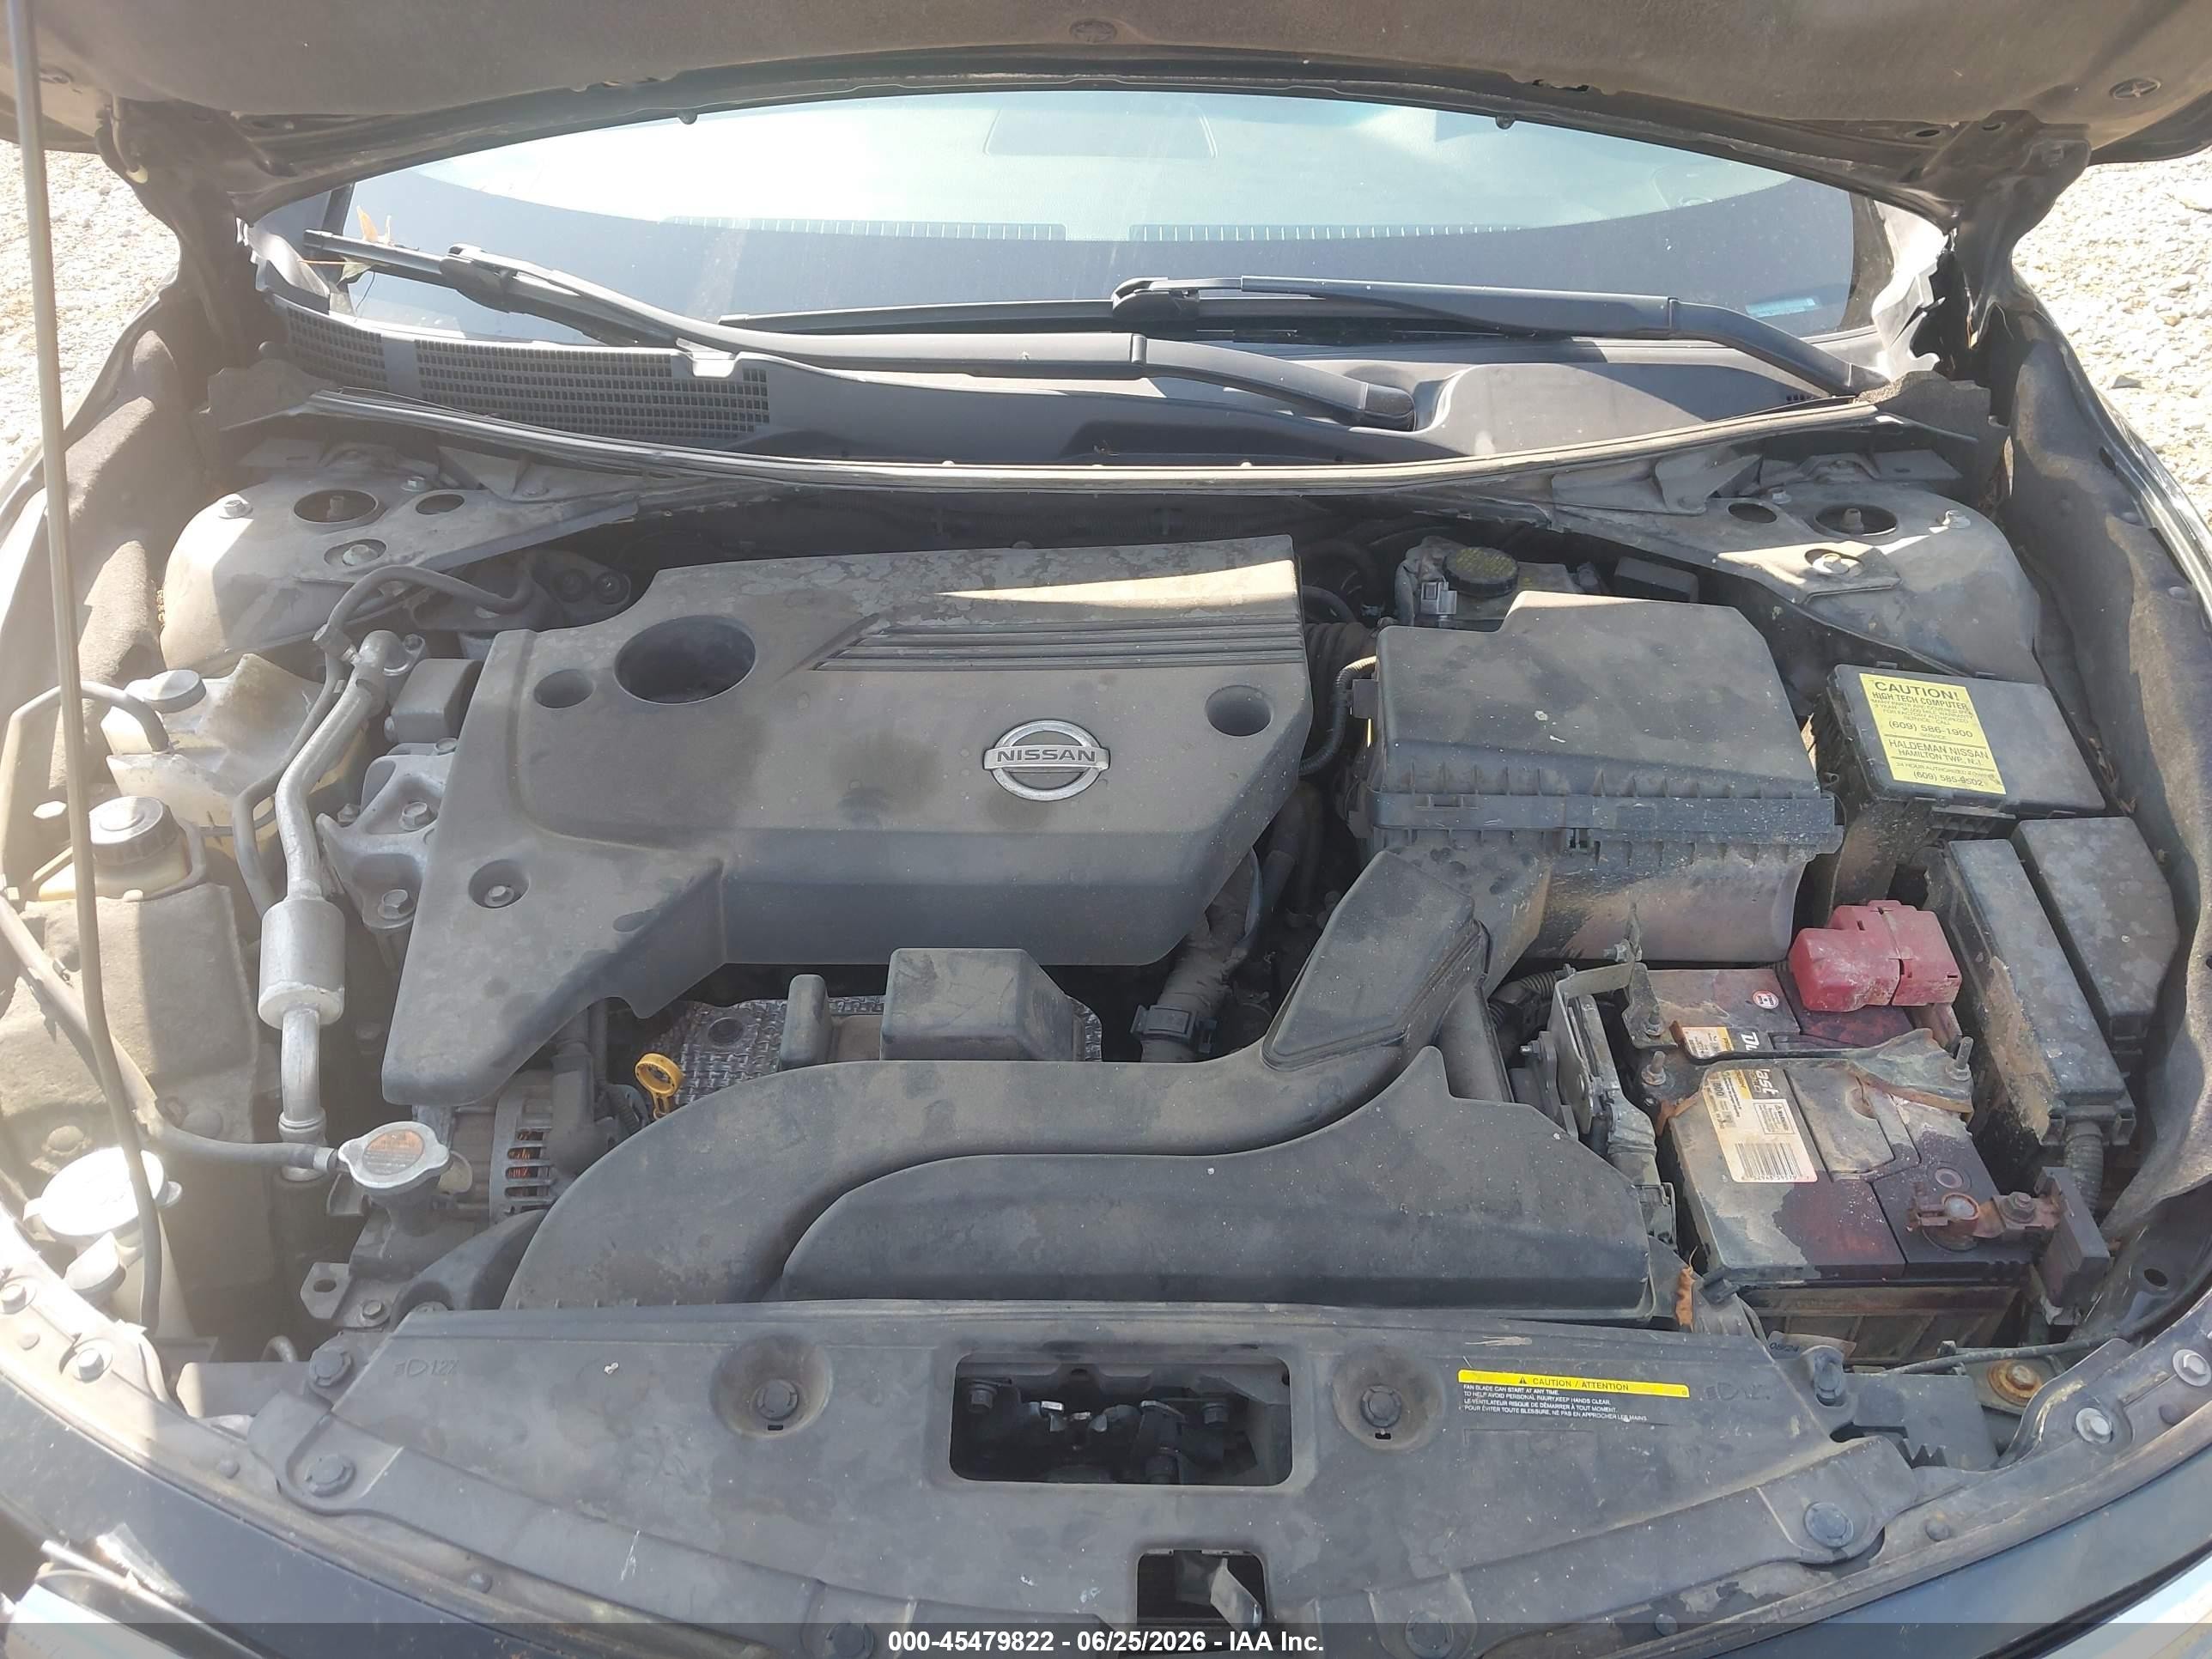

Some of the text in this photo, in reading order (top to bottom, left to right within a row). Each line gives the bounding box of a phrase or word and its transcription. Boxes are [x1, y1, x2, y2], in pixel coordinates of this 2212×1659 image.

[1875, 682, 1960, 701] CAUTION!
[1871, 691, 1968, 710] HIGH TECH COMPUTER
[1889, 721, 1972, 738] (609) 586-1900
[1888, 739, 1990, 760] HALDEMAN NISSAN
[1899, 750, 1942, 761] HAMILTON
[997, 750, 1096, 763] NISSAN
[1913, 771, 1937, 782] (609)
[1532, 1378, 1572, 1389] CAUTION
[1581, 1382, 1630, 1391] ATTENTION
[1581, 1412, 1618, 1420] APPROCHER
